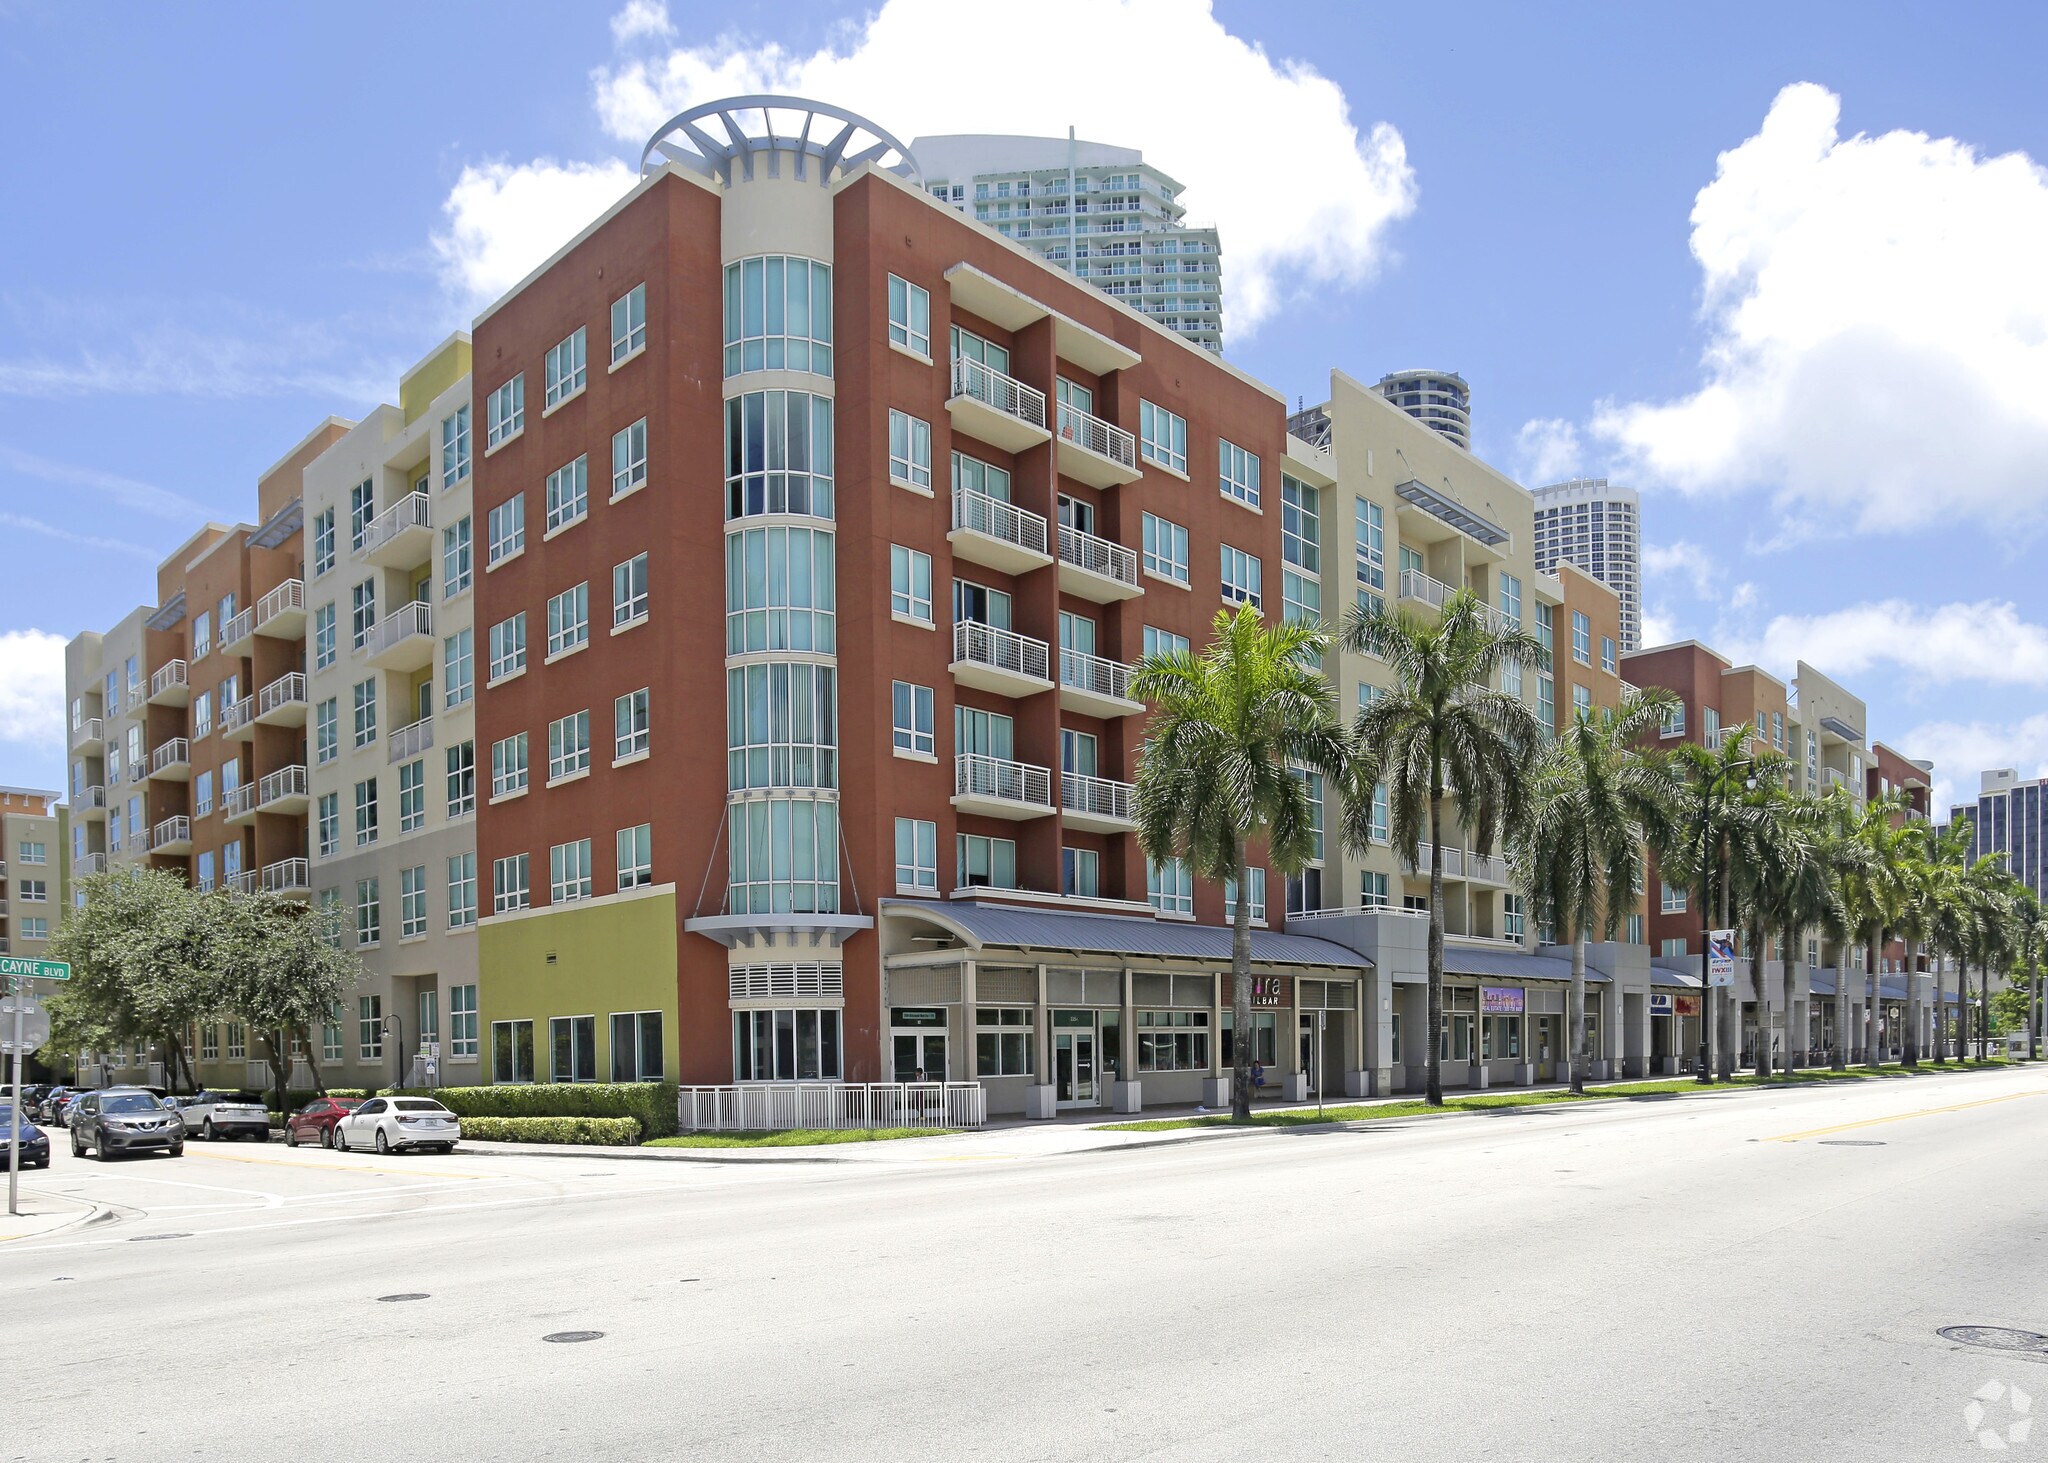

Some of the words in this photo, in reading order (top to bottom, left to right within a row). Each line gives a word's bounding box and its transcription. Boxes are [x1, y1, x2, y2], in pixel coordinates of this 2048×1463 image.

[1, 960, 40, 975] CAYNE
[44, 967, 64, 977] BLVD
[1252, 996, 1278, 1005] ILBAR
